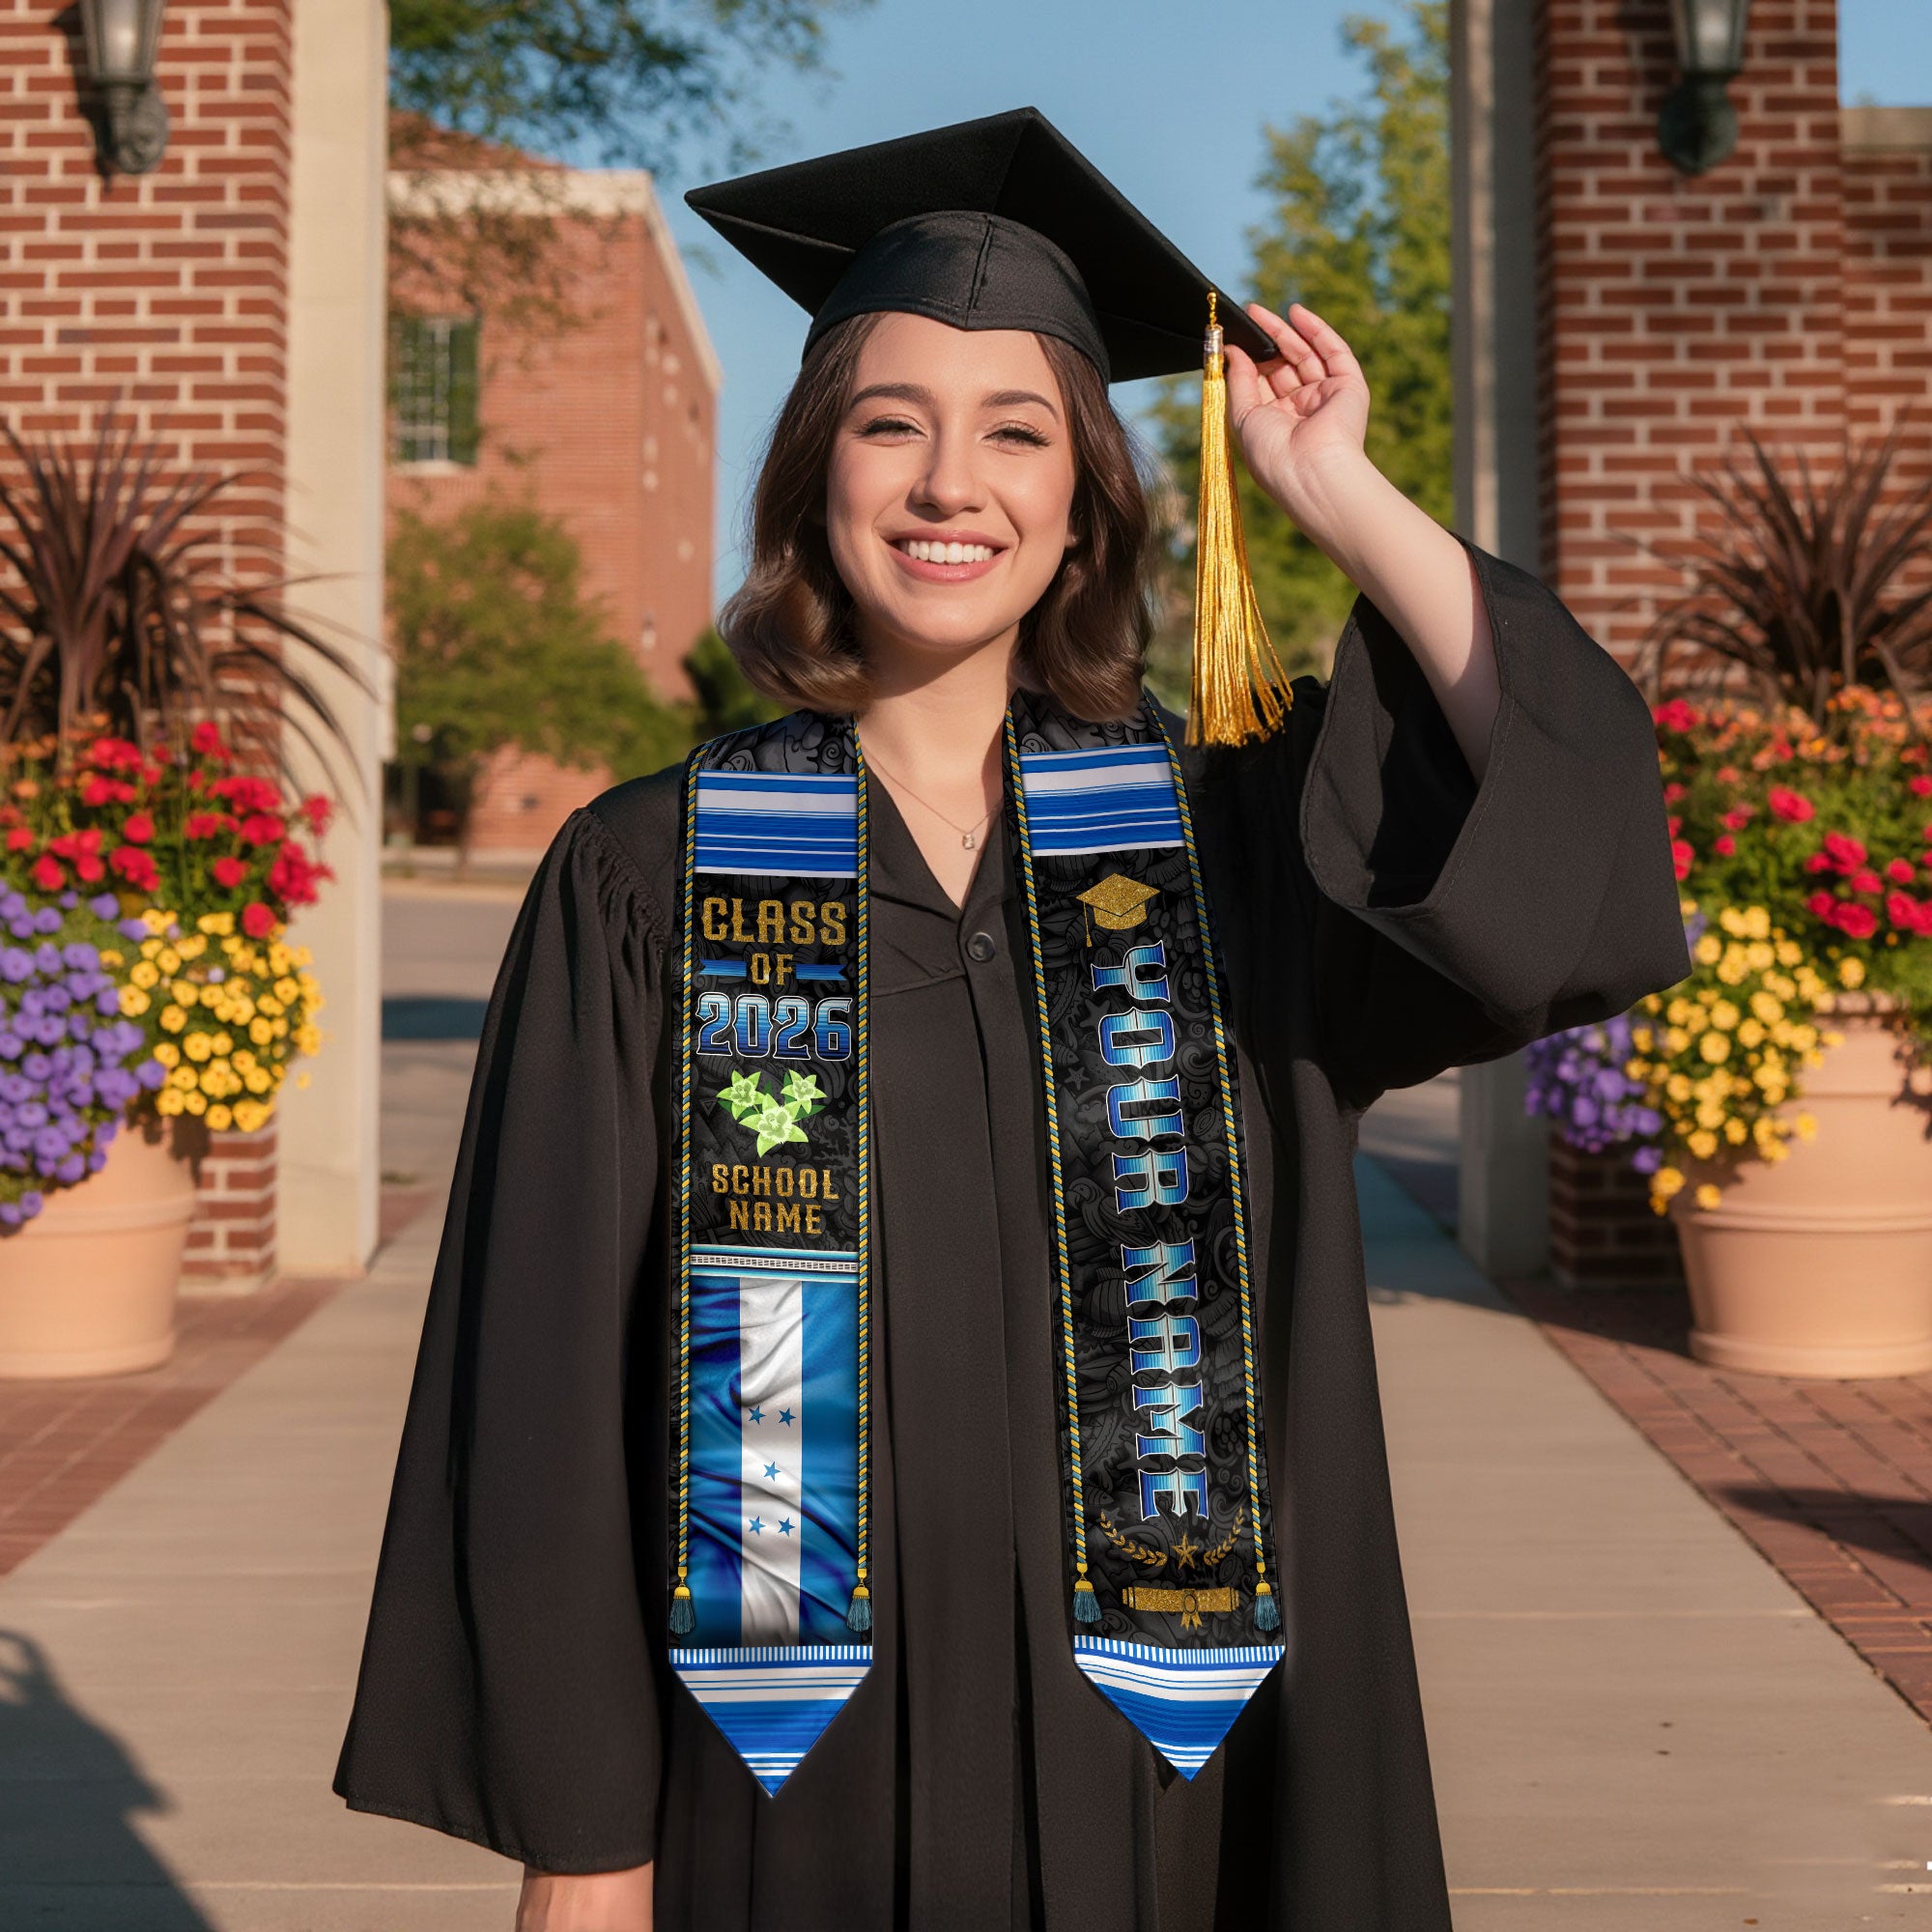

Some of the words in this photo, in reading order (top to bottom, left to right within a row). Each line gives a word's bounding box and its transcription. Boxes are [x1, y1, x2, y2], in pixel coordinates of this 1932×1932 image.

[701, 896, 847, 946] CLASS
[751, 952, 793, 986] OF
[695, 991, 853, 1062] 2026
[1091, 940, 1188, 1215] YOUR
[711, 1163, 839, 1200] SCHOOL
[729, 1200, 822, 1235] NAME
[1121, 1236, 1209, 1521] NAME
